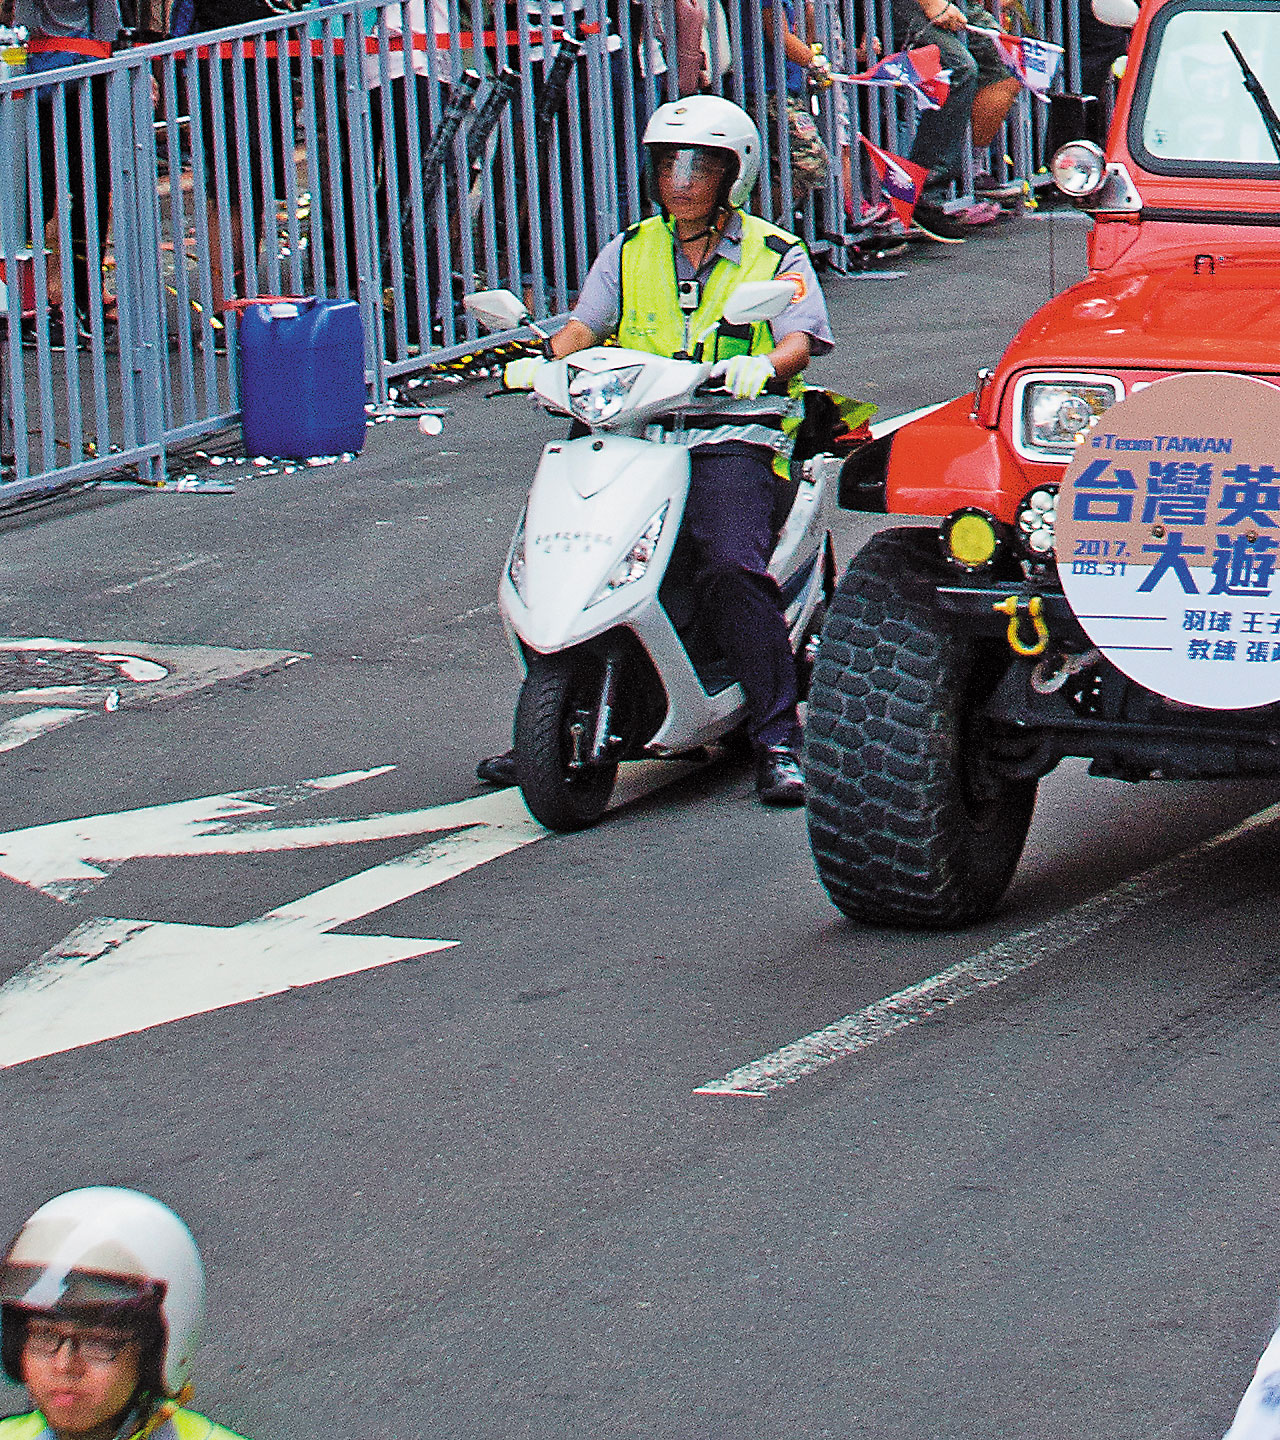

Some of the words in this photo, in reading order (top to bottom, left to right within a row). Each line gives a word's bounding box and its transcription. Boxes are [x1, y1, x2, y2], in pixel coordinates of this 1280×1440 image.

[1092, 434, 1233, 454] #TeamTAIWAN
[1073, 539, 1130, 556] 2017.
[1072, 560, 1127, 576] 08.31
[1183, 610, 1233, 632] 羽球
[1187, 639, 1237, 661] 教練
